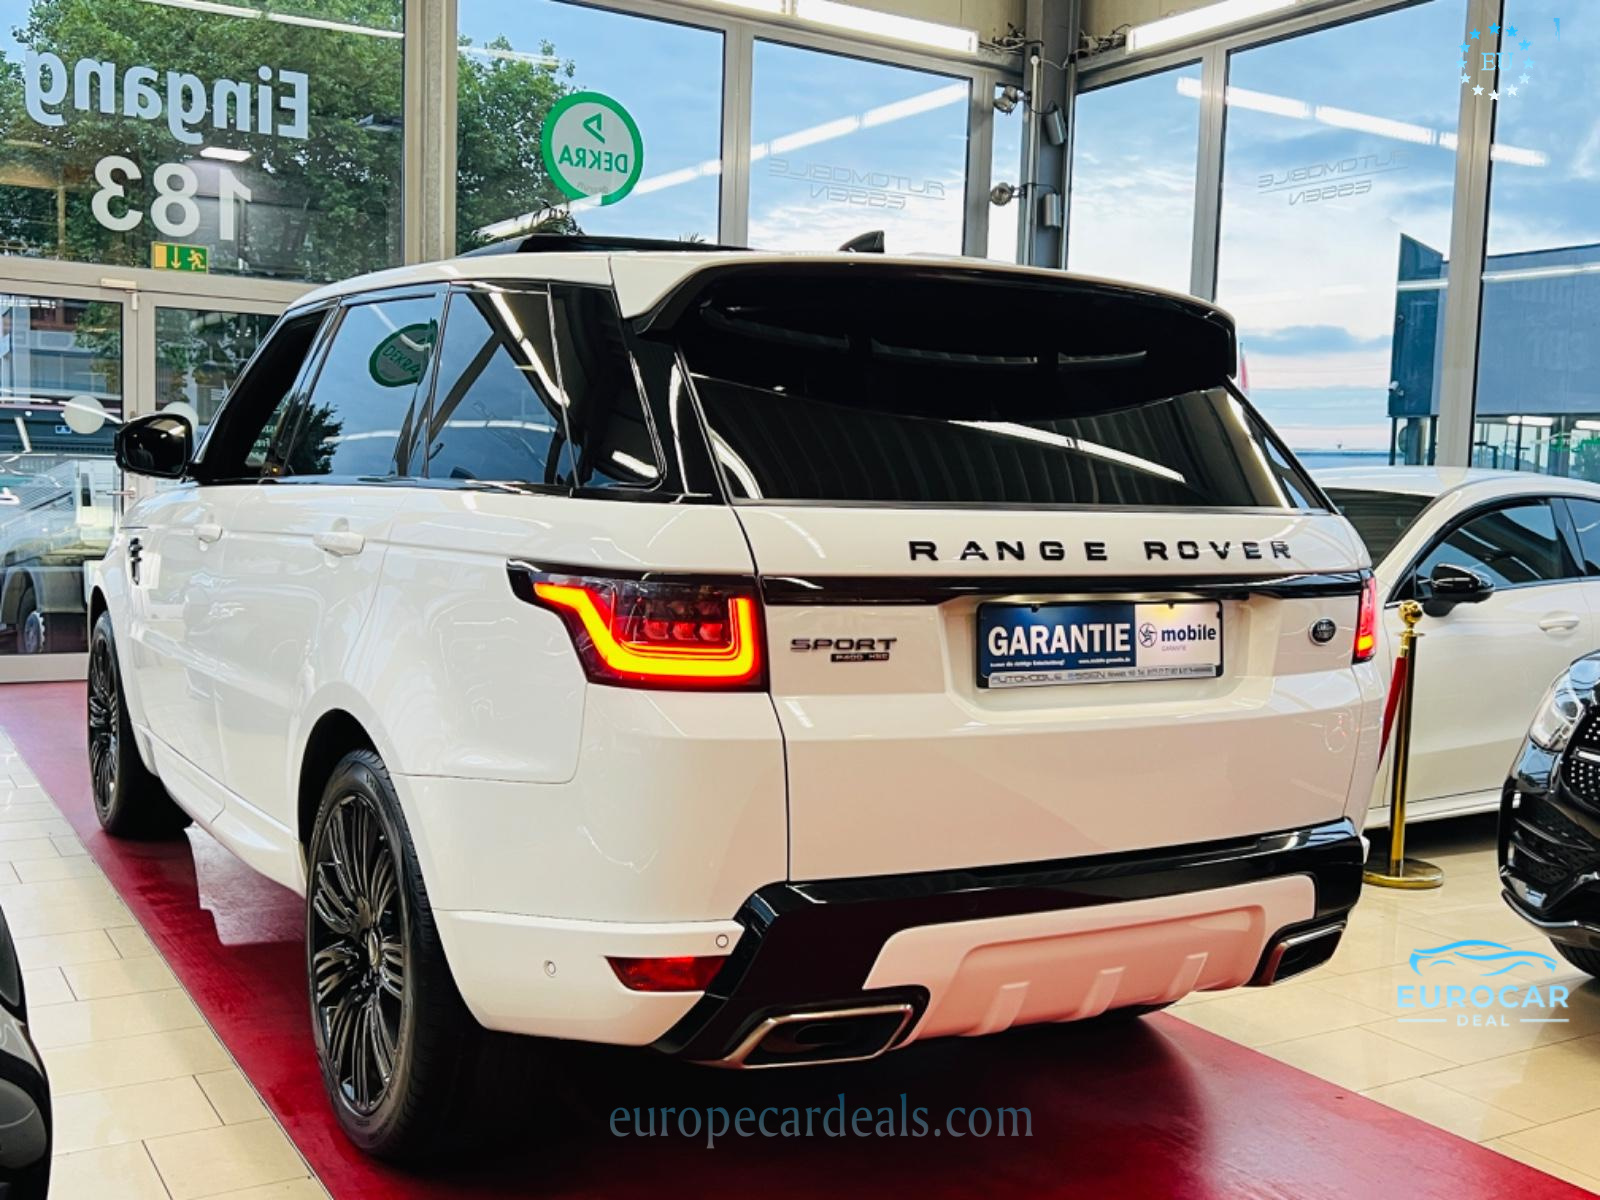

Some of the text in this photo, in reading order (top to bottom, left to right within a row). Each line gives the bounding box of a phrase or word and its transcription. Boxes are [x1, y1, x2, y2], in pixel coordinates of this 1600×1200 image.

[908, 540, 1292, 561] RANGE ROVER
[988, 623, 1131, 656] GARANTIE
[1161, 624, 1217, 642] mobile
[790, 638, 897, 651] SPORT
